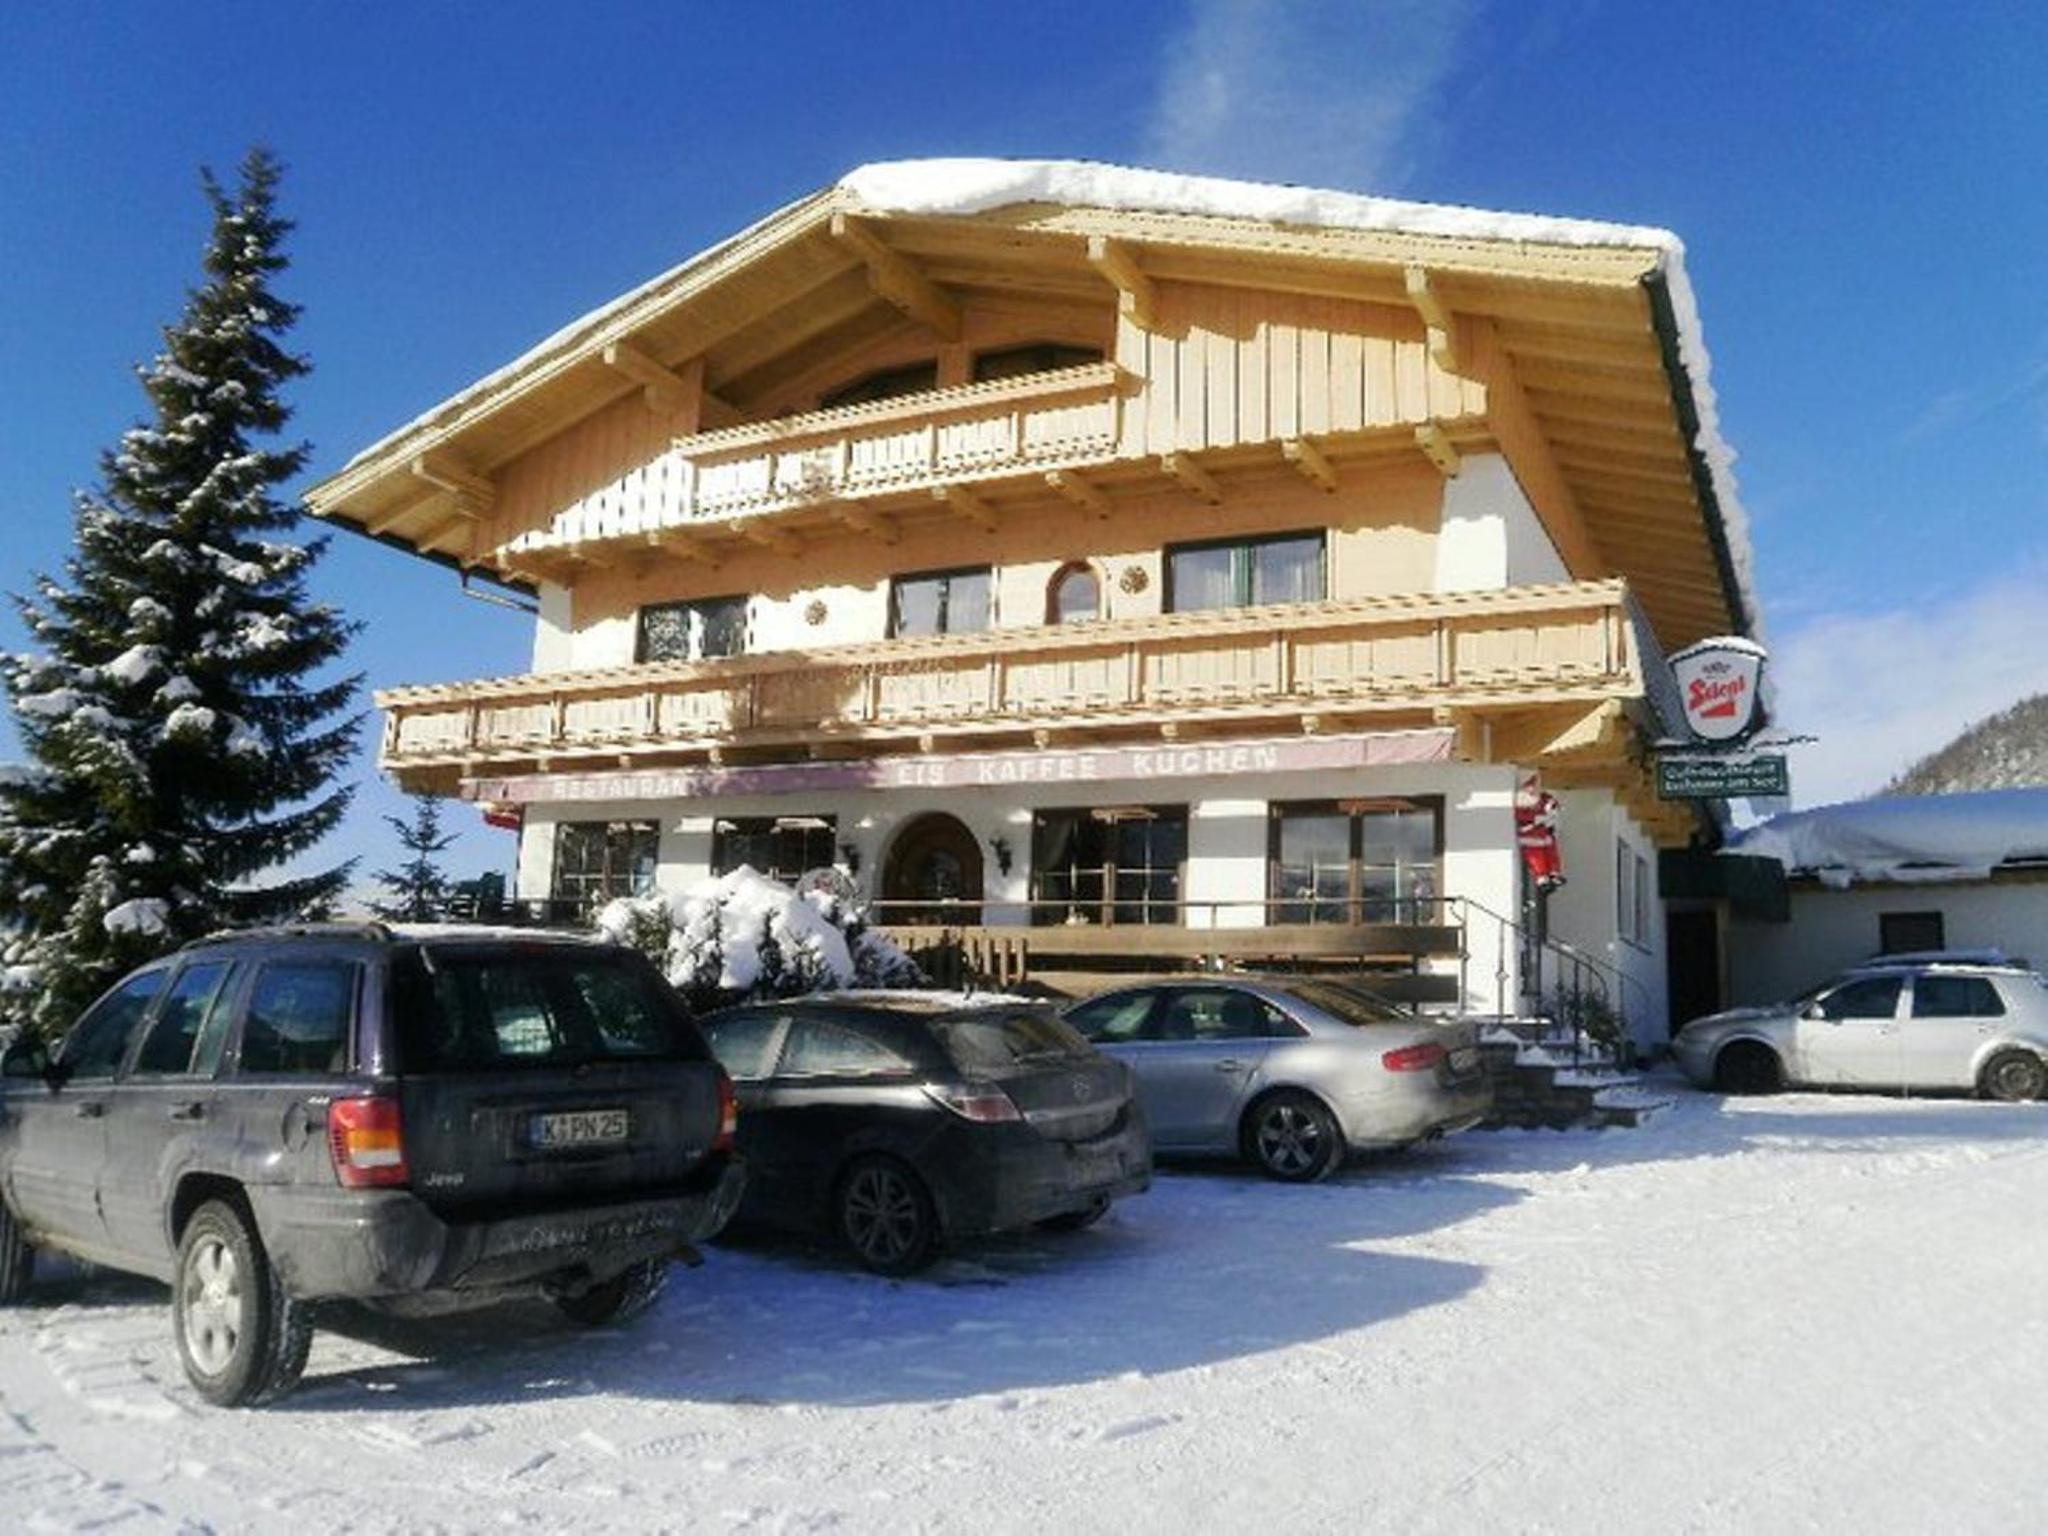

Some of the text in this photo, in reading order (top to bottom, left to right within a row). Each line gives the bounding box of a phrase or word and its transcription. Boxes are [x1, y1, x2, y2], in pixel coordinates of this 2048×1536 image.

[898, 745, 1279, 787] EIS KAFFEE KUCHEN
